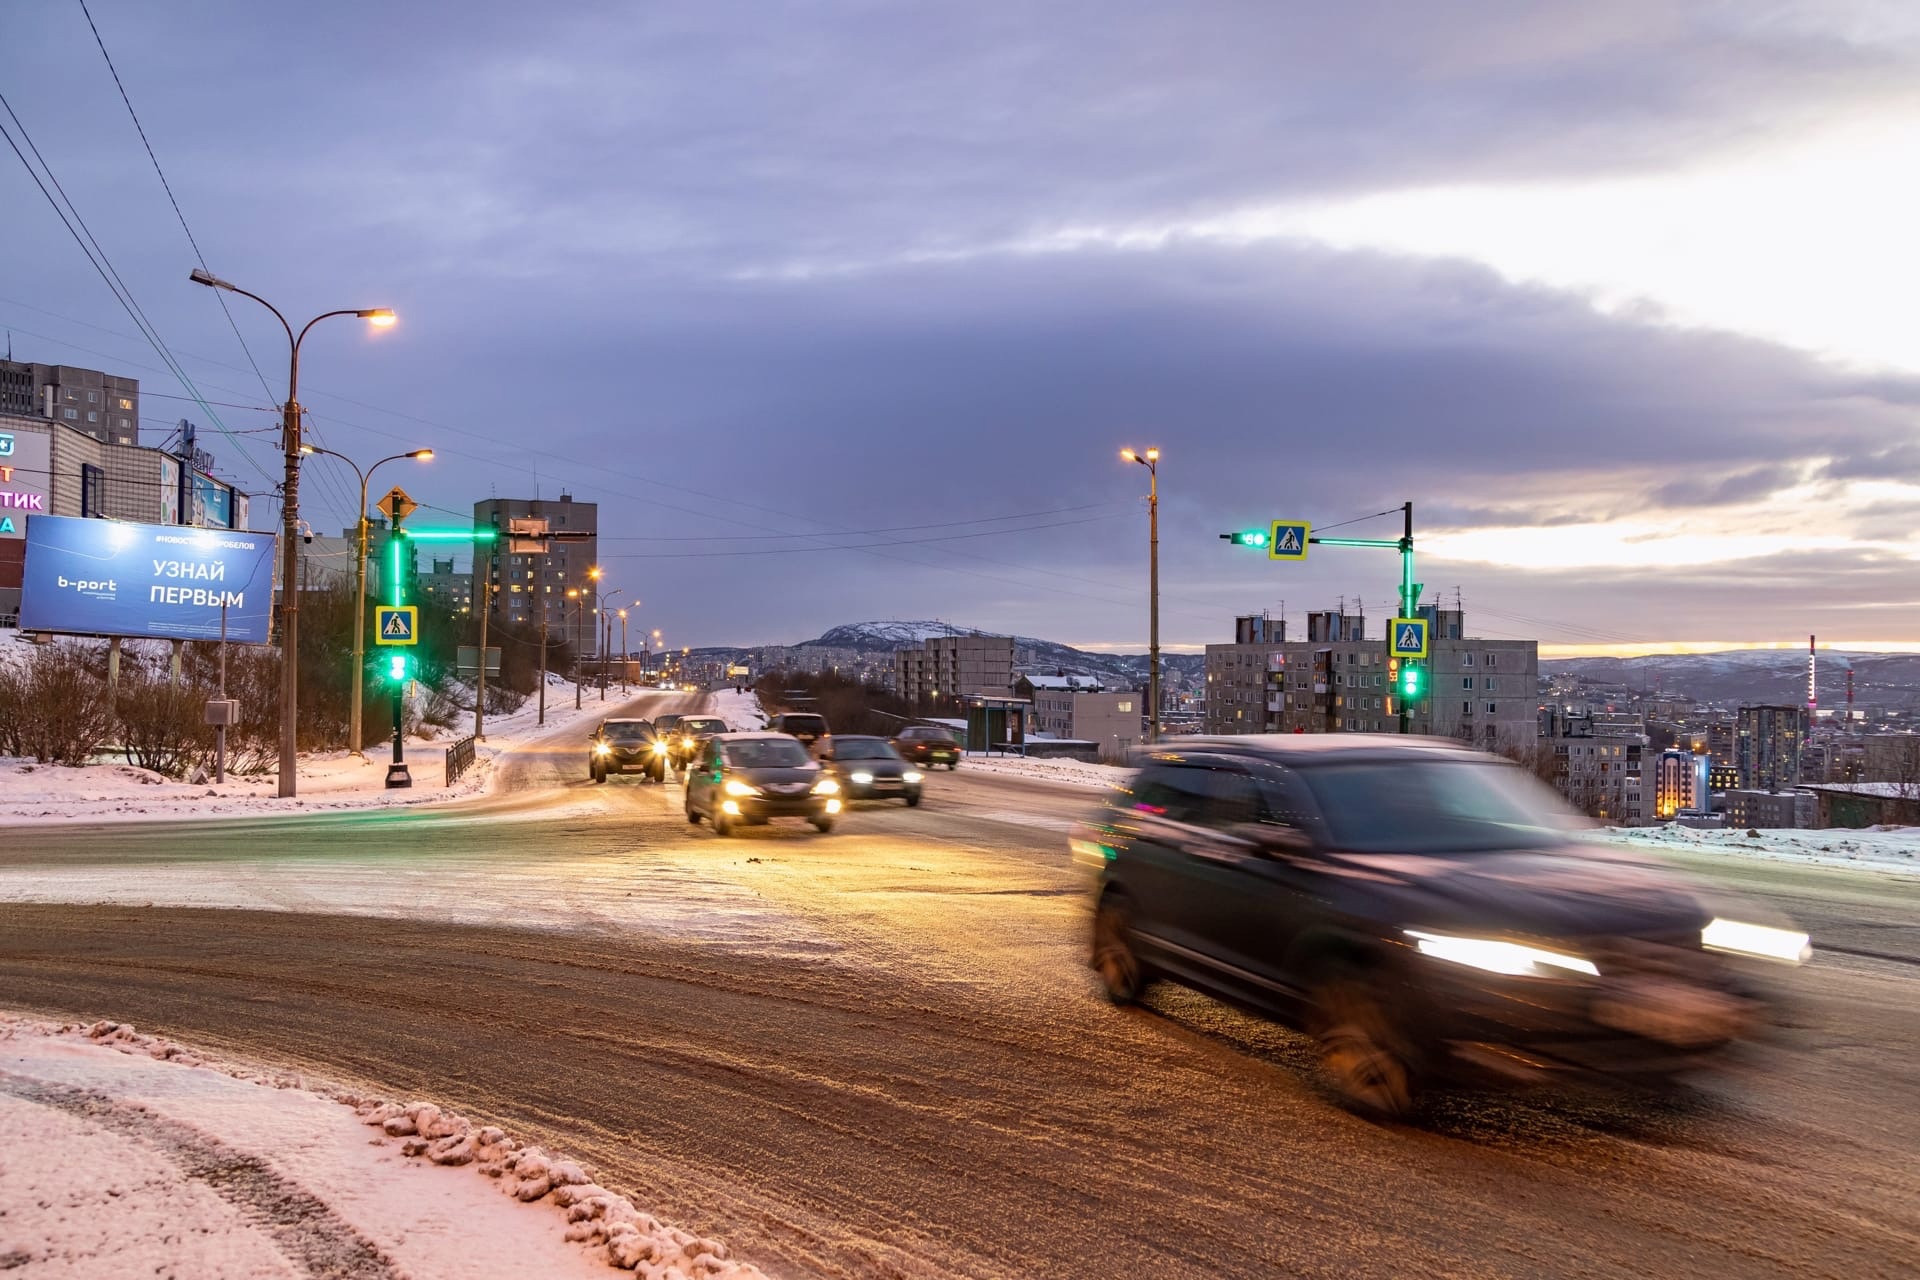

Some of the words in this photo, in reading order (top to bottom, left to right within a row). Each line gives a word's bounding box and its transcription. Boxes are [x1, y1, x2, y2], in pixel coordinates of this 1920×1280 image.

[0, 491, 43, 510] ТИК
[152, 559, 225, 582] УЗНАЙ
[58, 576, 117, 592] b-port
[150, 585, 245, 609] ПЕРВЫМ
